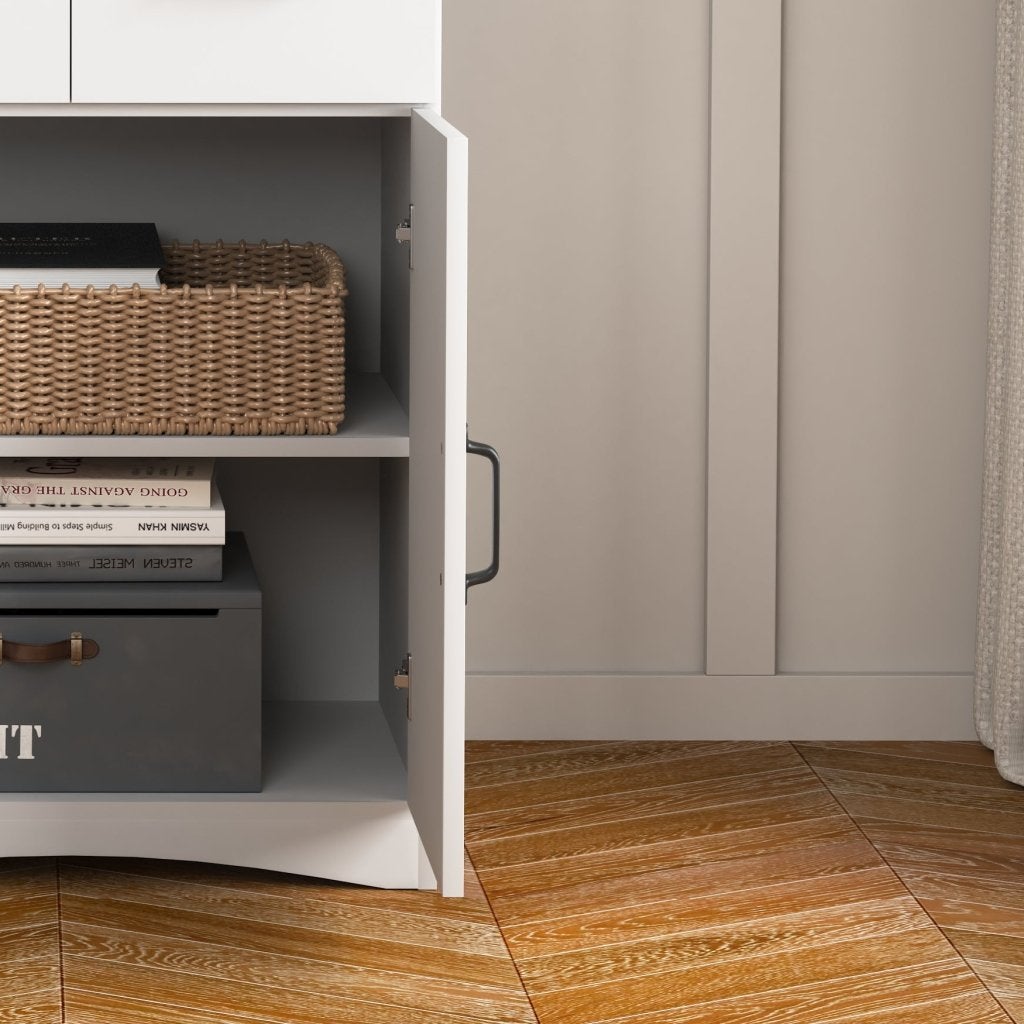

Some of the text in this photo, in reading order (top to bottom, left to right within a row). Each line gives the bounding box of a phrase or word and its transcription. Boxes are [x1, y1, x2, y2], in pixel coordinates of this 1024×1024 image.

[36, 485, 66, 495] THE
[70, 486, 135, 496] AGAINST
[140, 487, 188, 497] GOING
[17, 521, 49, 531] Building
[62, 522, 84, 531] Steps
[86, 522, 113, 531] Simple
[138, 522, 210, 532] YASMIN KHAN
